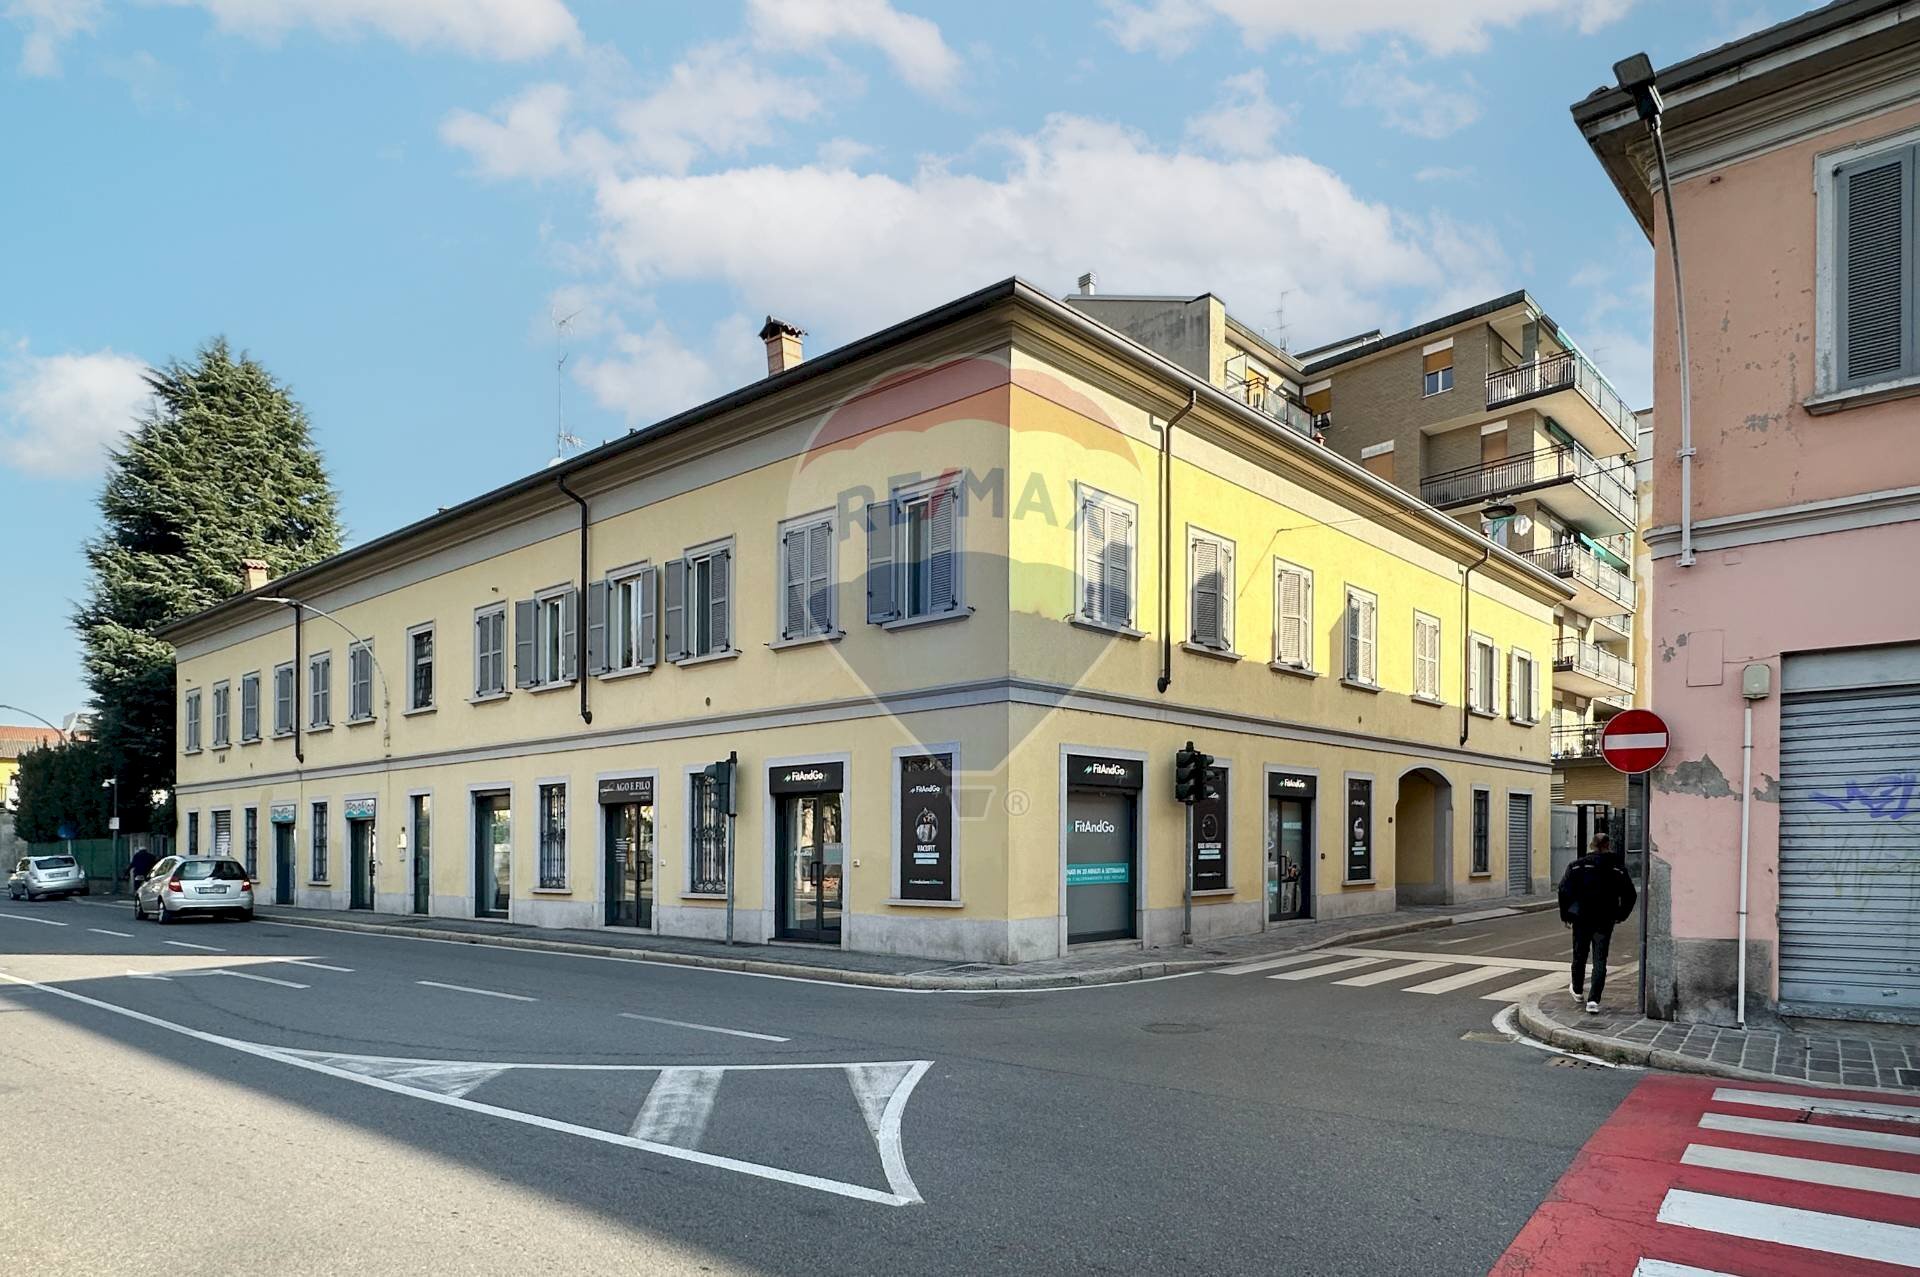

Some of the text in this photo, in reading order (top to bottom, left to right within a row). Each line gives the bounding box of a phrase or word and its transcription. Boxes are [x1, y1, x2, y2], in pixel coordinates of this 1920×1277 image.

[791, 769, 824, 782] FitAndGo
[1093, 763, 1125, 776] FitAndGo
[616, 781, 651, 792] AGO E FILO
[915, 784, 941, 793] FitAndGo
[1284, 778, 1306, 788] FitAndGo
[1074, 819, 1115, 833] FitAndGo
